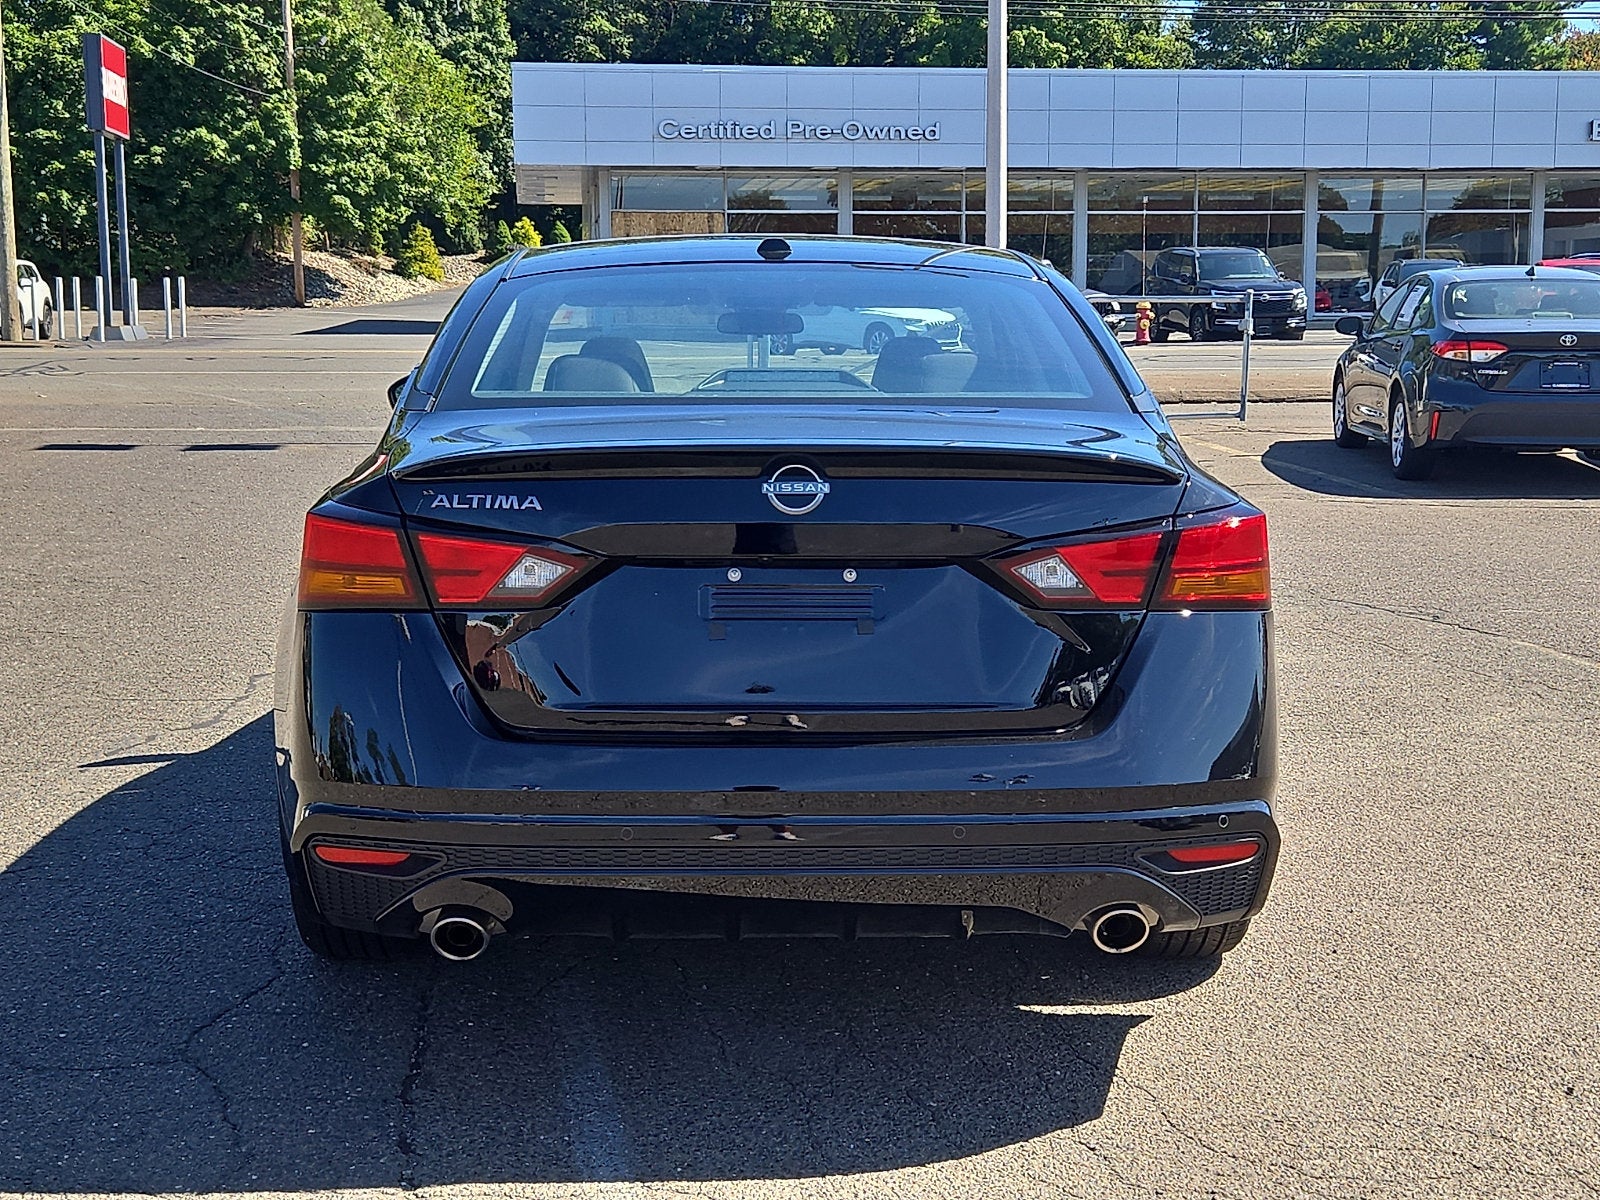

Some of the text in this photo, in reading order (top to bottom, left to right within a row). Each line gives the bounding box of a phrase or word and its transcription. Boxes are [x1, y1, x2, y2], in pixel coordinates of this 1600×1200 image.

[657, 119, 941, 141] Certified Pre-Owned
[763, 483, 829, 492] NISSAN
[430, 494, 543, 511] ALTIMA
